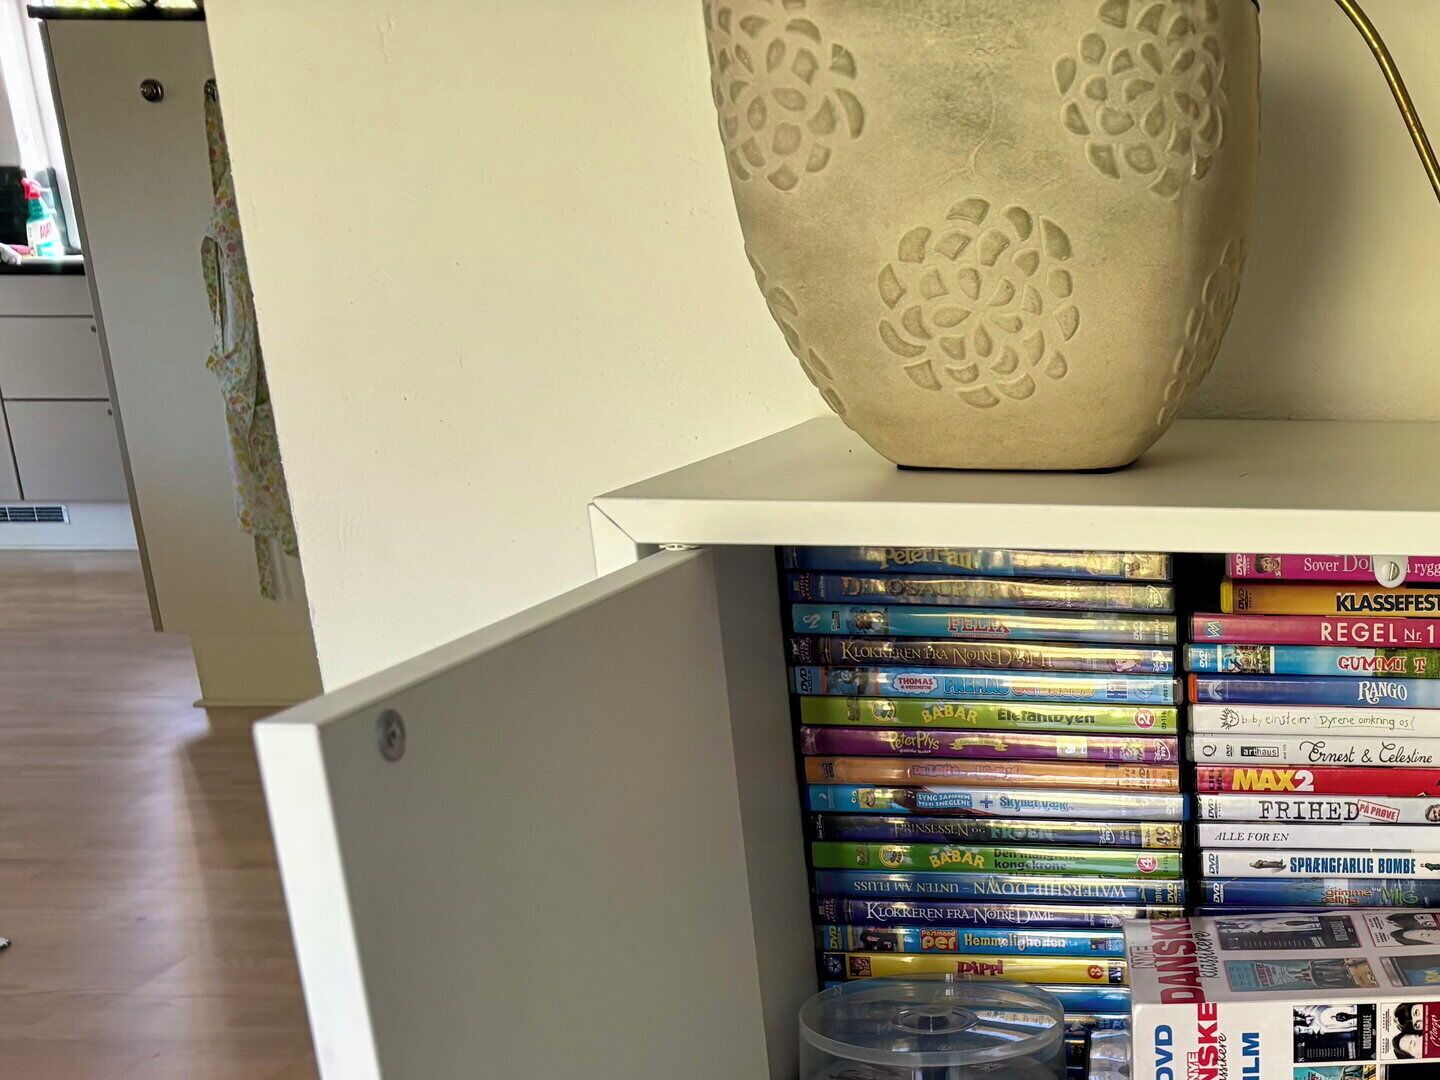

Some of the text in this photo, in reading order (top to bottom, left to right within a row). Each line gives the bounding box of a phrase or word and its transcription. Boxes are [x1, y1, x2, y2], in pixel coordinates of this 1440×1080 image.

[1320, 622, 1435, 644] REGEL Nr. 1
[1338, 655, 1406, 673] GUMMI
[1358, 681, 1408, 704] RANGO
[921, 703, 978, 724] BABAR
[1320, 715, 1354, 728] Dyrene
[1399, 719, 1410, 728] os
[917, 731, 941, 751] Plys
[1300, 741, 1433, 764] Ernest & Celestine
[1258, 800, 1360, 821] FRIHED
[1215, 832, 1289, 842] ALLE FOR EN
[929, 849, 986, 869] BABAR
[1289, 856, 1416, 874] SPRÆNGFARLIG BOMBE
[854, 881, 891, 892] FLUSS
[895, 880, 913, 892] AM
[917, 881, 959, 893] UNTEN
[865, 901, 943, 922] KLOKKEREN
[947, 909, 970, 919] FRA
[922, 937, 954, 951] per
